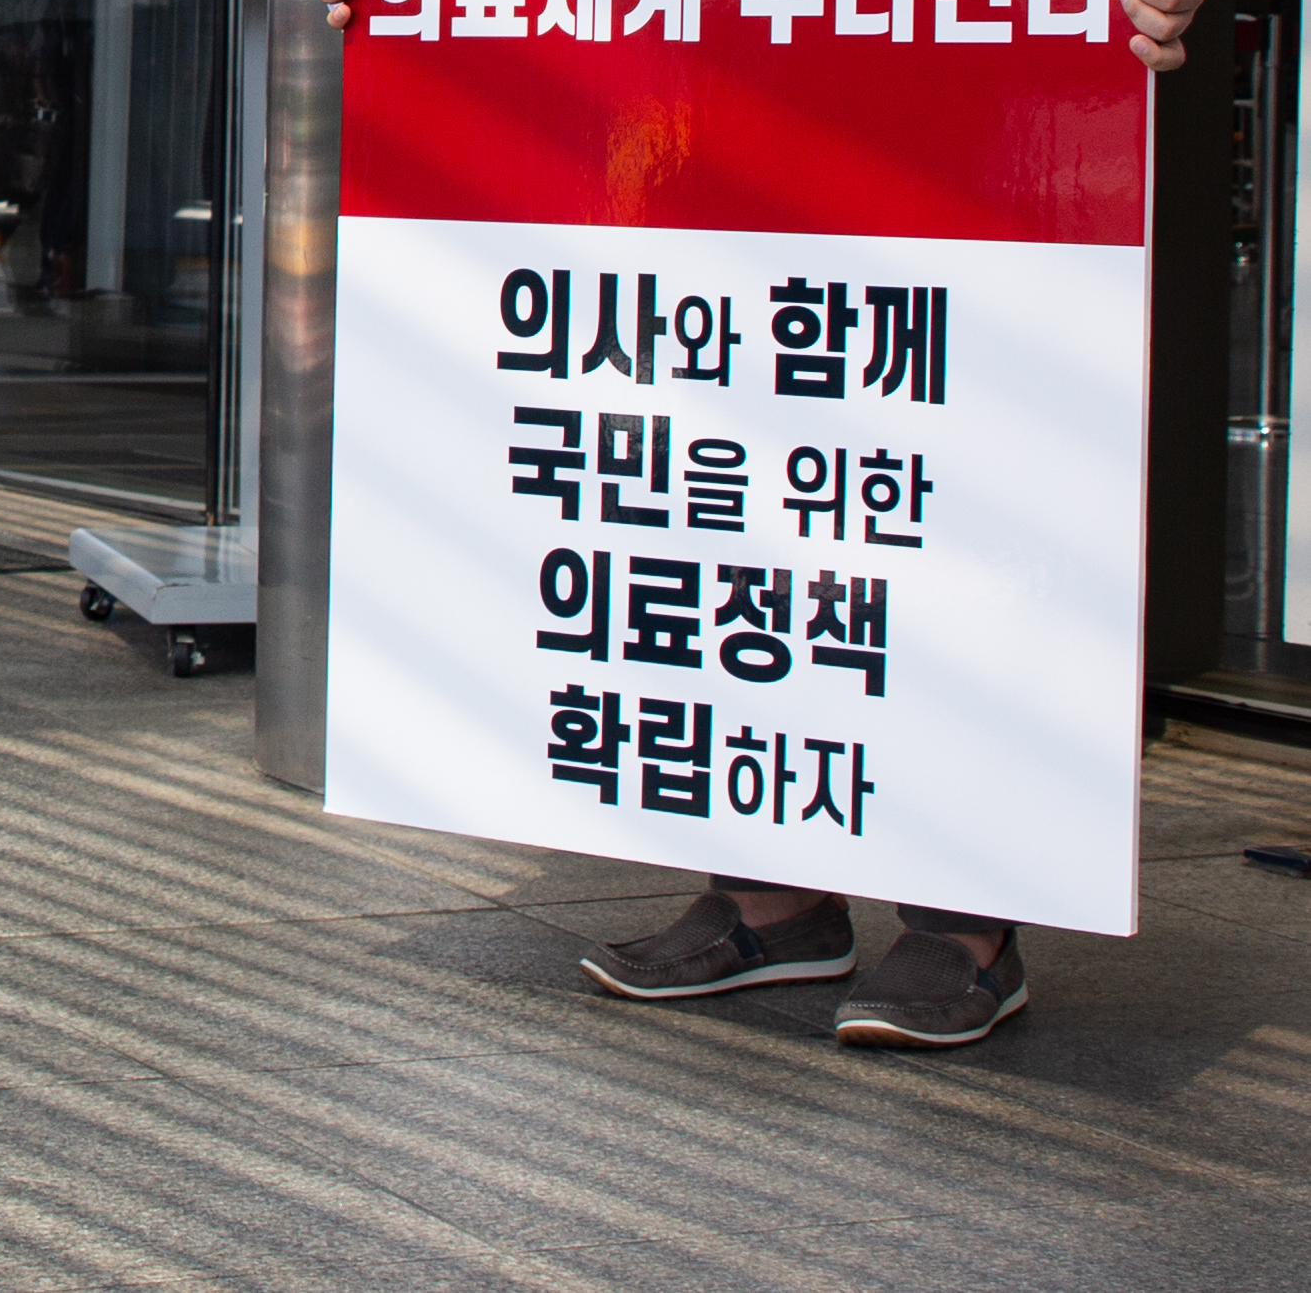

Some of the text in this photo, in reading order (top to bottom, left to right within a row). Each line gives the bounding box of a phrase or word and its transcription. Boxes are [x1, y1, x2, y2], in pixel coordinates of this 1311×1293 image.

[496, 267, 948, 405] 의사와 함께
[508, 405, 934, 549] 국민을 위한
[535, 547, 888, 698] 의료정책
[547, 683, 875, 837] 확립하자
